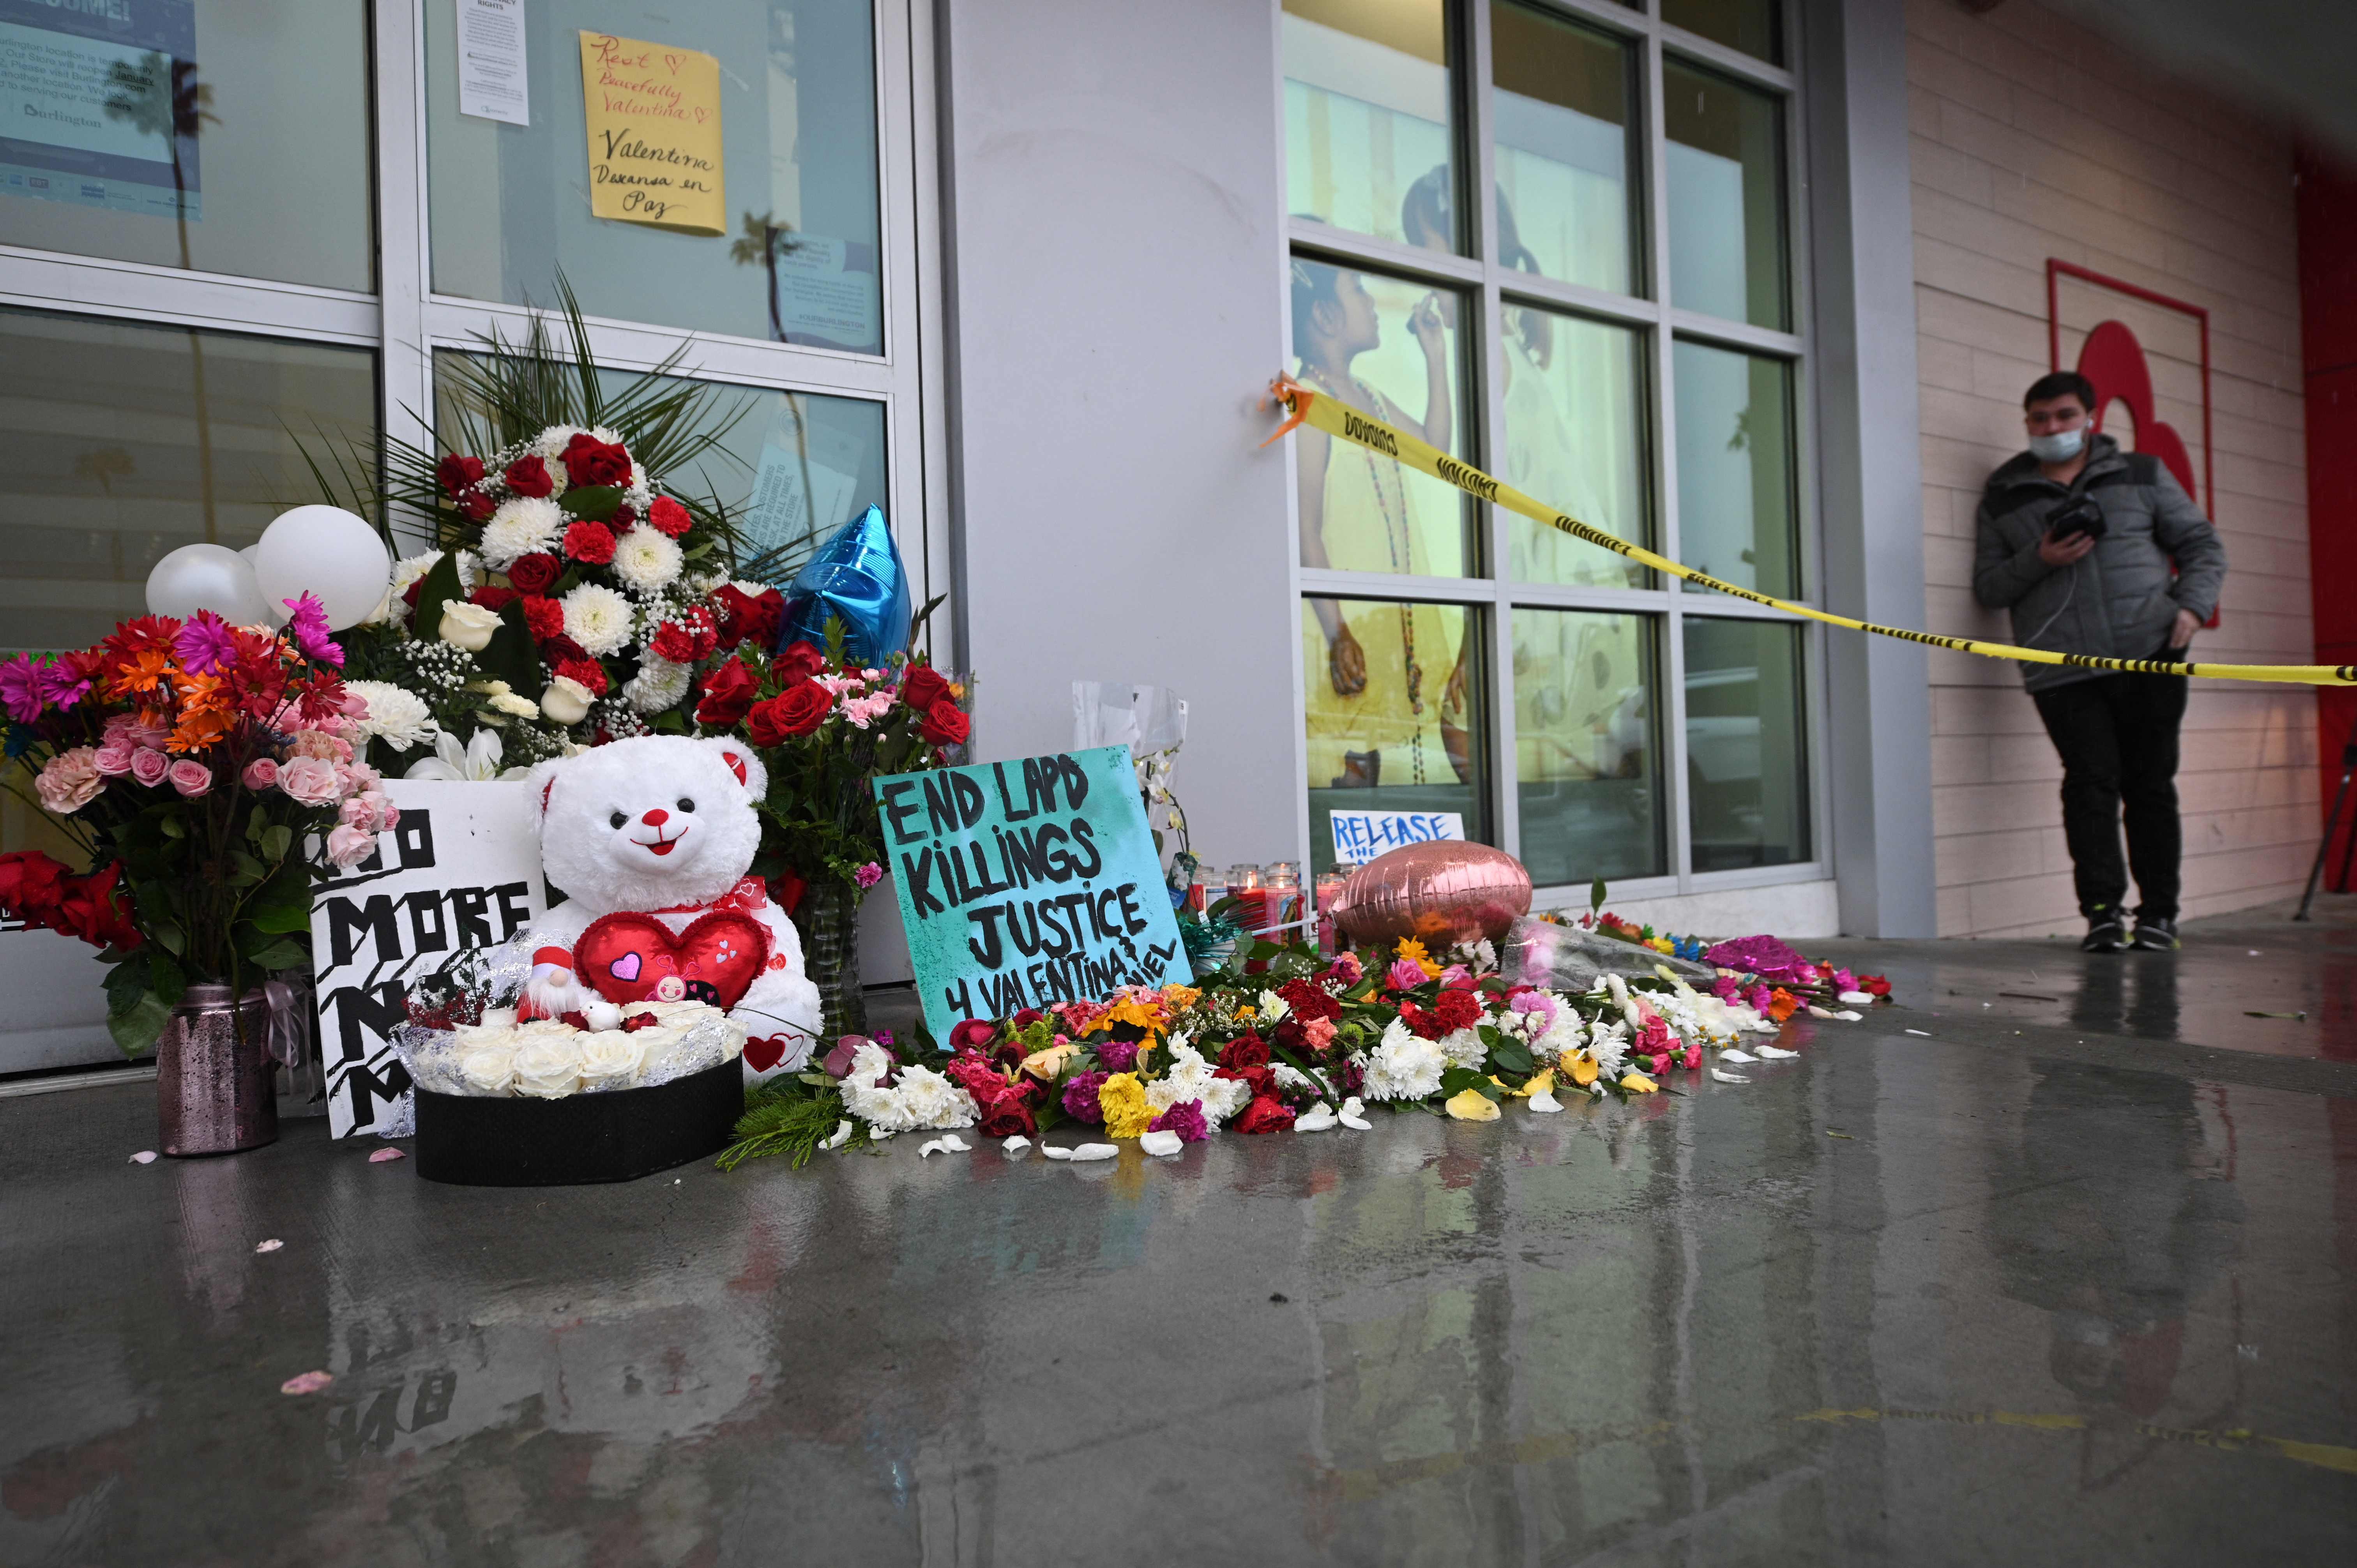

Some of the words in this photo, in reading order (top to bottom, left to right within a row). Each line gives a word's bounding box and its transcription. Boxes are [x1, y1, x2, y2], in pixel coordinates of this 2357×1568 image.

[478, 0, 503, 10] RIGHTS
[0, 39, 42, 51] urlington
[46, 45, 84, 59] location
[99, 57, 153, 75] temporarily
[6, 49, 25, 58] Our
[28, 53, 56, 65] Store
[58, 60, 74, 69] will
[78, 64, 111, 76] reopen
[115, 71, 154, 85] January
[590, 36, 650, 69] Rest
[1, 71, 39, 83] another
[88, 85, 105, 95] We
[108, 89, 128, 100] look
[11, 60, 46, 73] Please
[50, 69, 69, 78] visit
[72, 72, 146, 93] Burlington.com
[597, 68, 681, 108] Peacefully
[8, 81, 18, 90] to
[21, 85, 58, 98] serving
[80, 96, 132, 111] customers
[604, 90, 691, 119] Valentina
[24, 104, 101, 128] Burlington
[599, 128, 713, 171] Valentina
[679, 179, 712, 192] en
[623, 191, 688, 219] Paz
[1345, 411, 1398, 457] CUIDADO
[776, 464, 786, 475] TO
[1437, 457, 1498, 503] CAUTION
[756, 464, 775, 512] CUSTOMERS
[766, 474, 783, 514] REQUIRED
[762, 513, 772, 530] ARE
[776, 500, 786, 515] ALL
[785, 494, 798, 519] STORE
[781, 519, 791, 534] THE
[883, 770, 985, 845] END
[993, 754, 1088, 821] LAPD
[1332, 814, 1453, 849] RELEASE
[1345, 846, 1379, 858] THE
[327, 881, 530, 966] MORE
[945, 978, 975, 1020] 4
